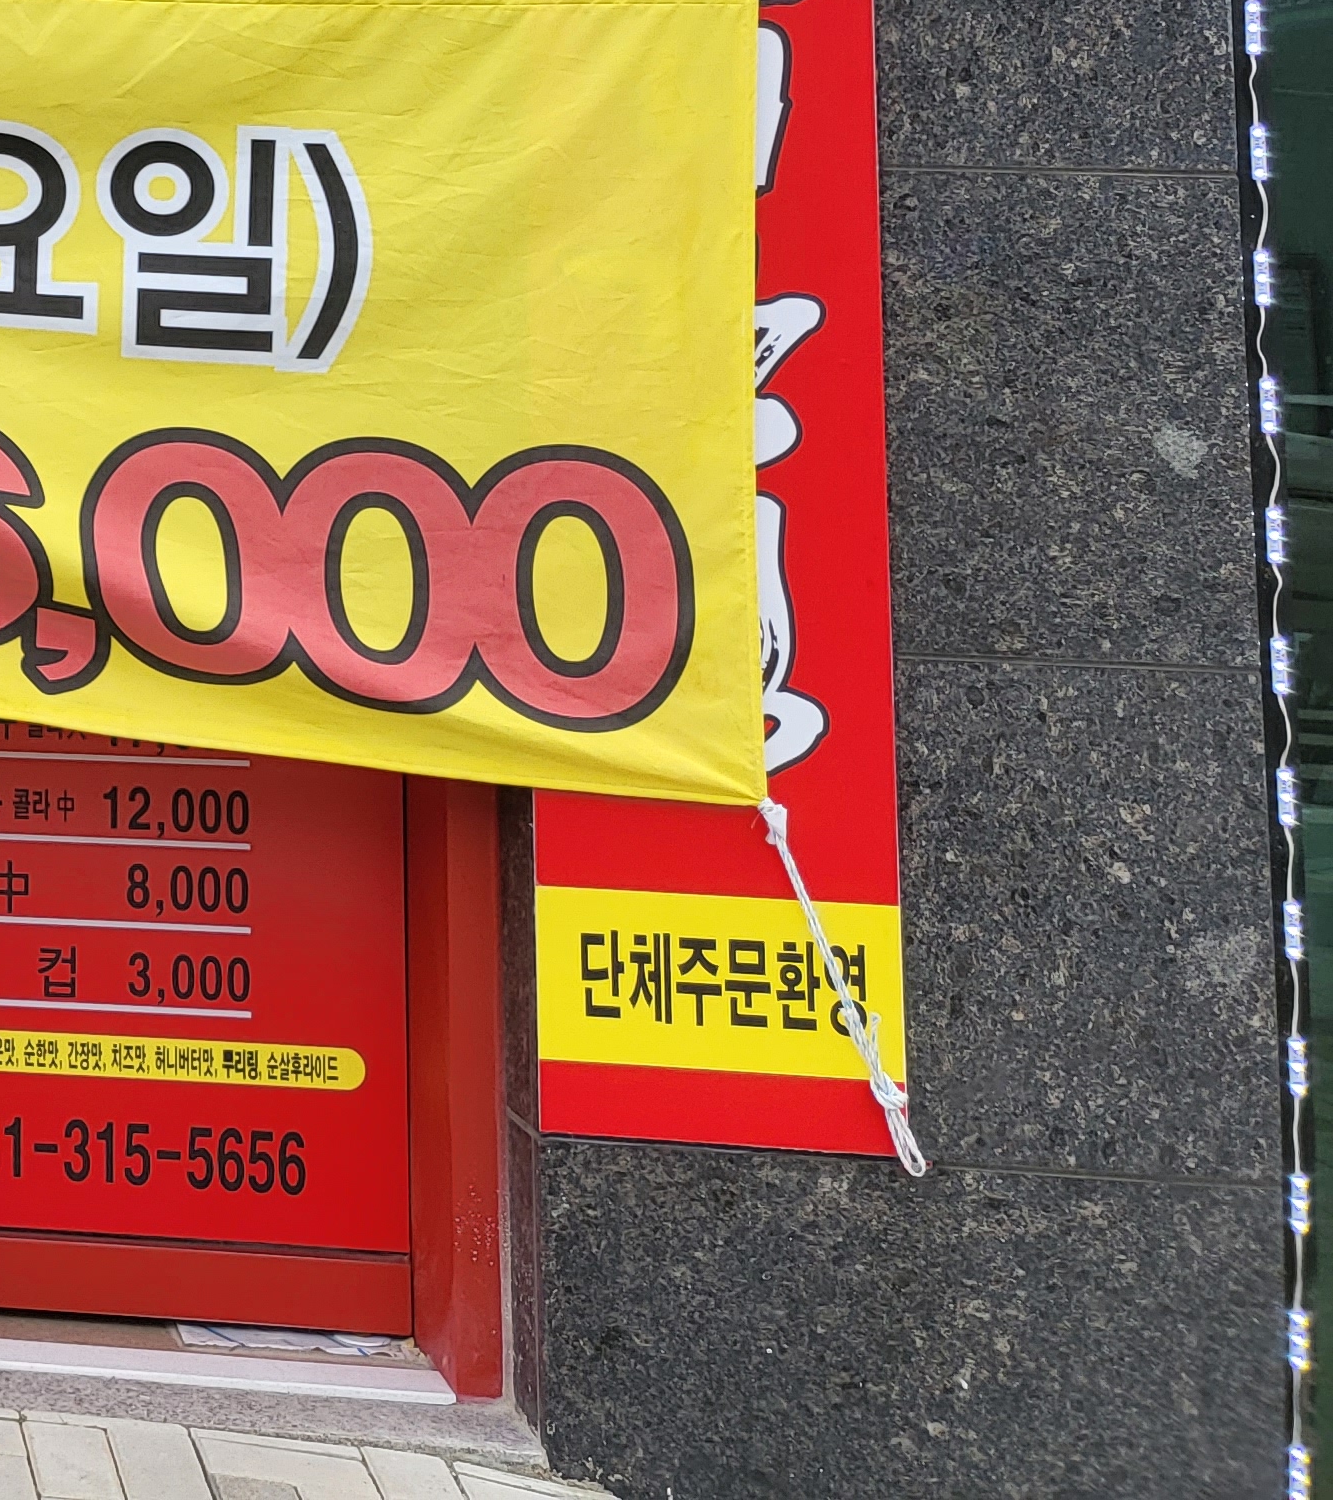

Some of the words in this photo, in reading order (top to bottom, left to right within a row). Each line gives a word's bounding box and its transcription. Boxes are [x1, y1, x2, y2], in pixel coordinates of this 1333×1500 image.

[103, 785, 249, 838] 12,000
[127, 863, 248, 917] 8,000
[37, 946, 78, 998] 컵
[127, 952, 251, 1005] 3,000
[580, 930, 868, 1037] 단체주문환영
[267, 1052, 339, 1084] 순살후라이드
